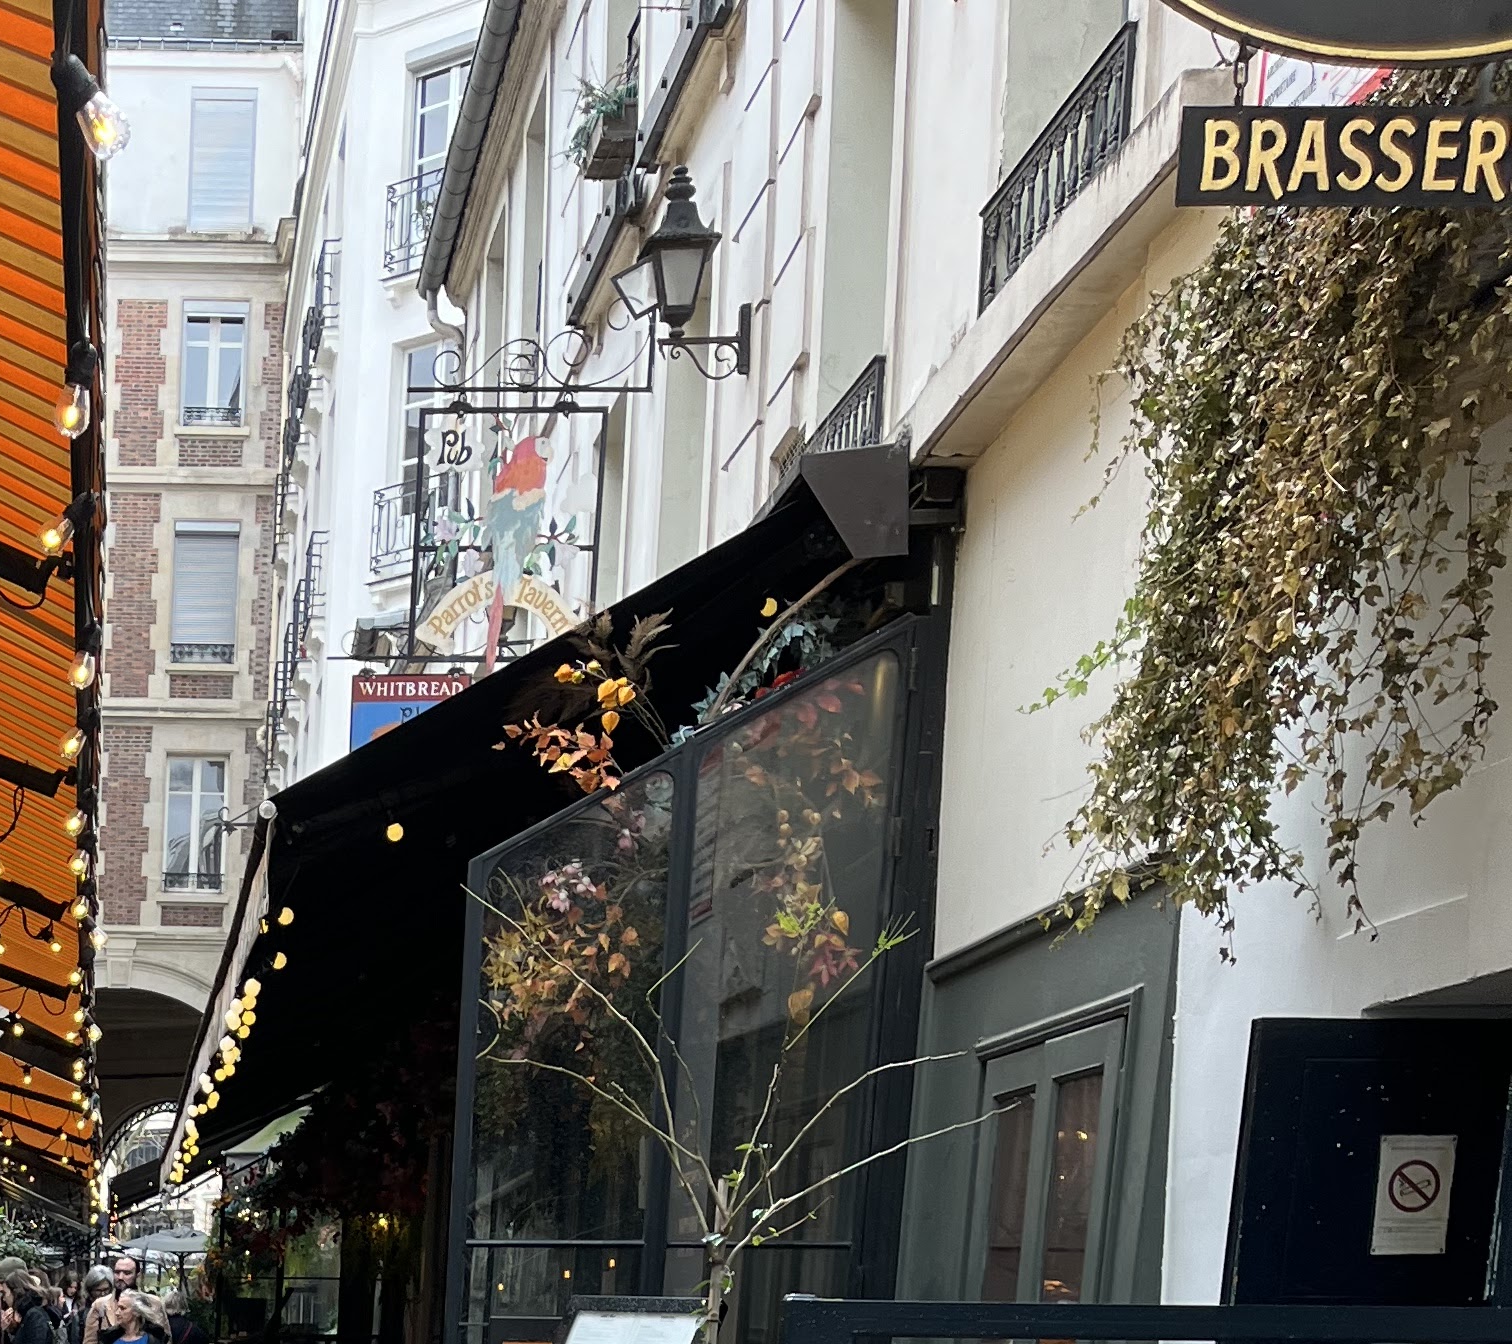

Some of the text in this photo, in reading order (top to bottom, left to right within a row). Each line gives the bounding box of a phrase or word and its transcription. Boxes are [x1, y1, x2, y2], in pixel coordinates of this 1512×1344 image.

[436, 429, 473, 466] Pub
[426, 577, 572, 640] Parrot's Tavern
[358, 681, 464, 697] WHITBREAD
